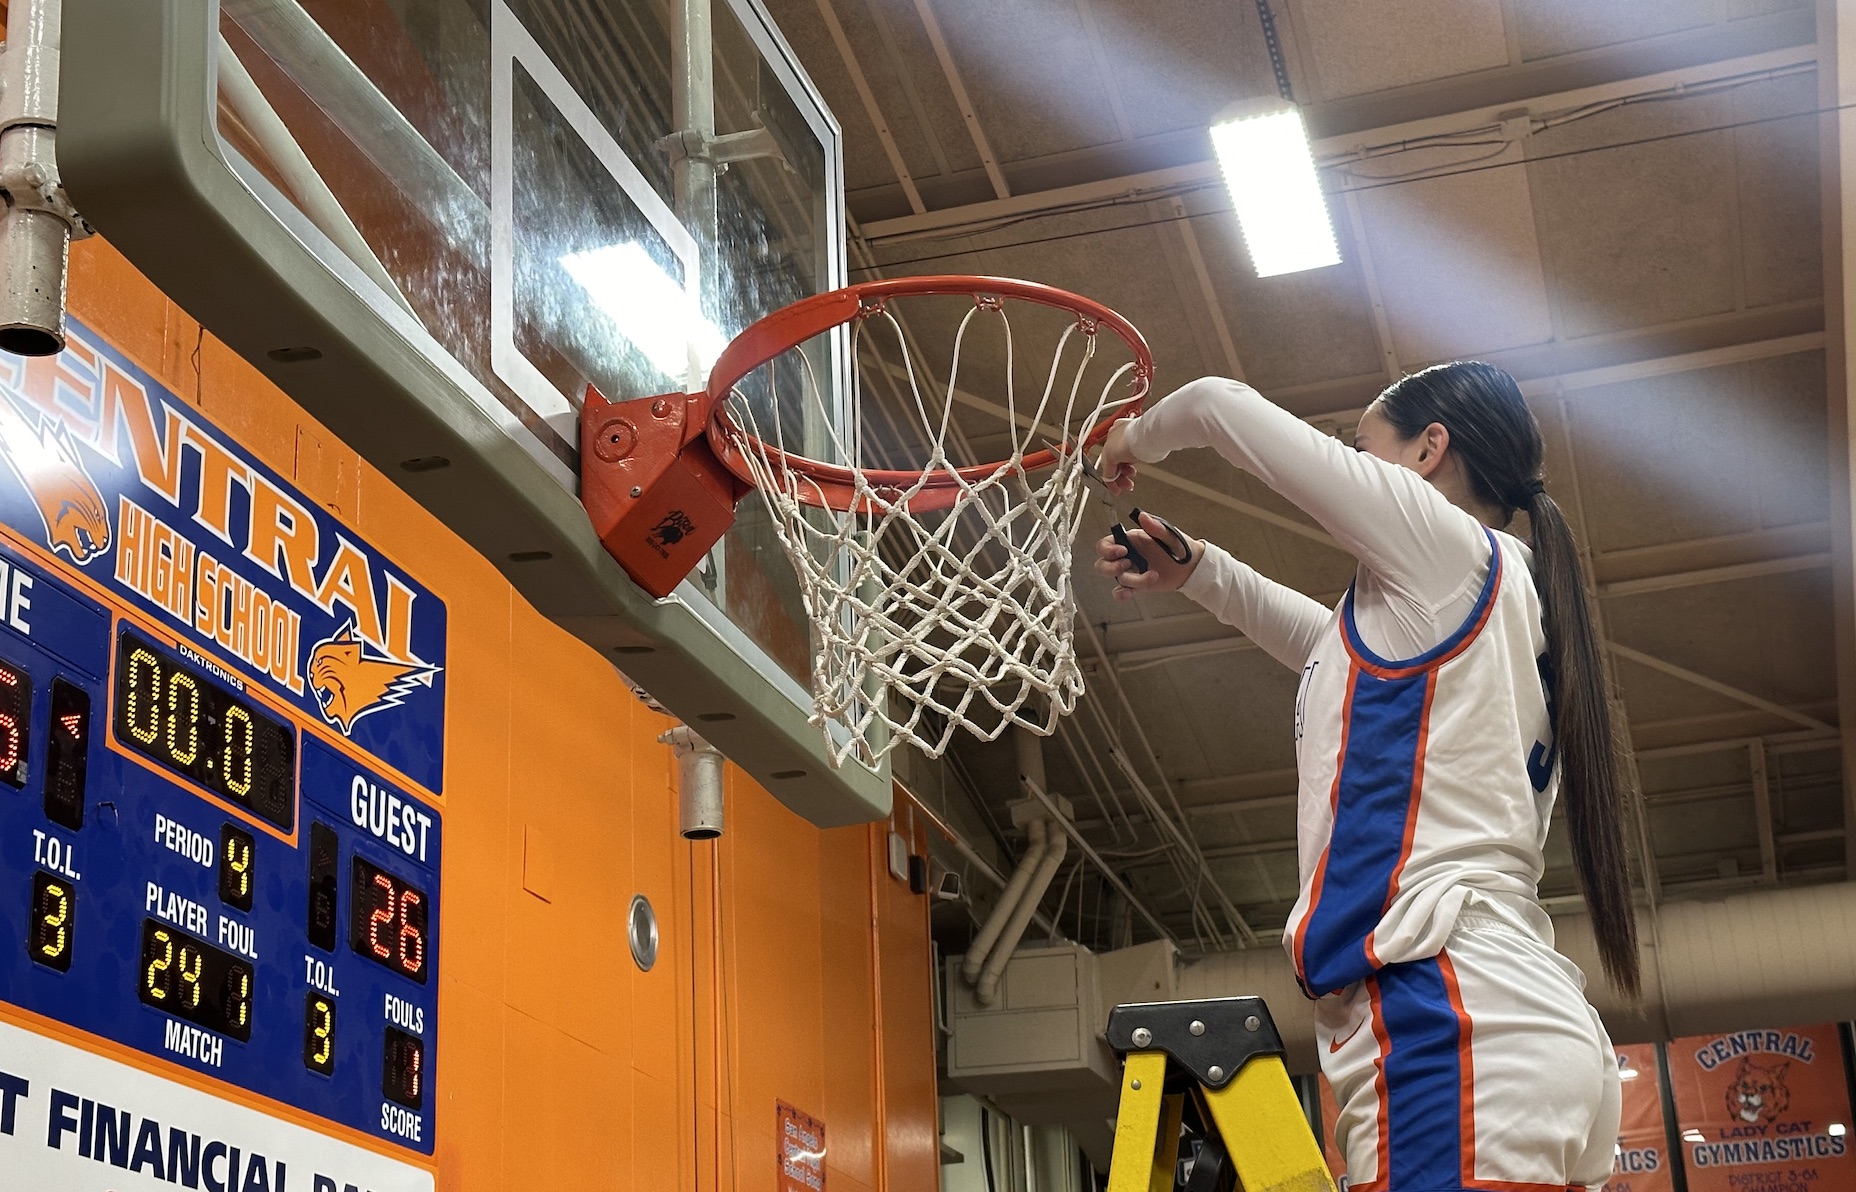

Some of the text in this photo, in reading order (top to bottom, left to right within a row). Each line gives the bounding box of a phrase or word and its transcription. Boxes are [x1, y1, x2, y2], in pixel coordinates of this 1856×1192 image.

[0, 328, 434, 688] ENTRAL
[114, 494, 304, 697] HIGH SCHOOL
[180, 644, 244, 692] DAKTRONICS
[154, 813, 214, 868] PERIOD
[351, 775, 431, 862] GUEST
[33, 830, 82, 880] T.O.L.
[227, 837, 249, 896] 4
[42, 884, 68, 958] 3
[146, 881, 259, 960] PLAYER FOUL
[370, 873, 423, 973] 26
[148, 930, 249, 1026] 24 1
[304, 955, 340, 997] T.O.L.
[313, 1000, 332, 1065] 3
[384, 992, 424, 1034] FOULS
[164, 1019, 223, 1068] MATCH
[1695, 1030, 1815, 1071] CENTRAL
[381, 1102, 422, 1142] SCORE
[1720, 1121, 1812, 1139] LADY CAT
[1694, 1134, 1846, 1168] GYMNASTICS
[1729, 1171, 1783, 1186] DISTRICT
